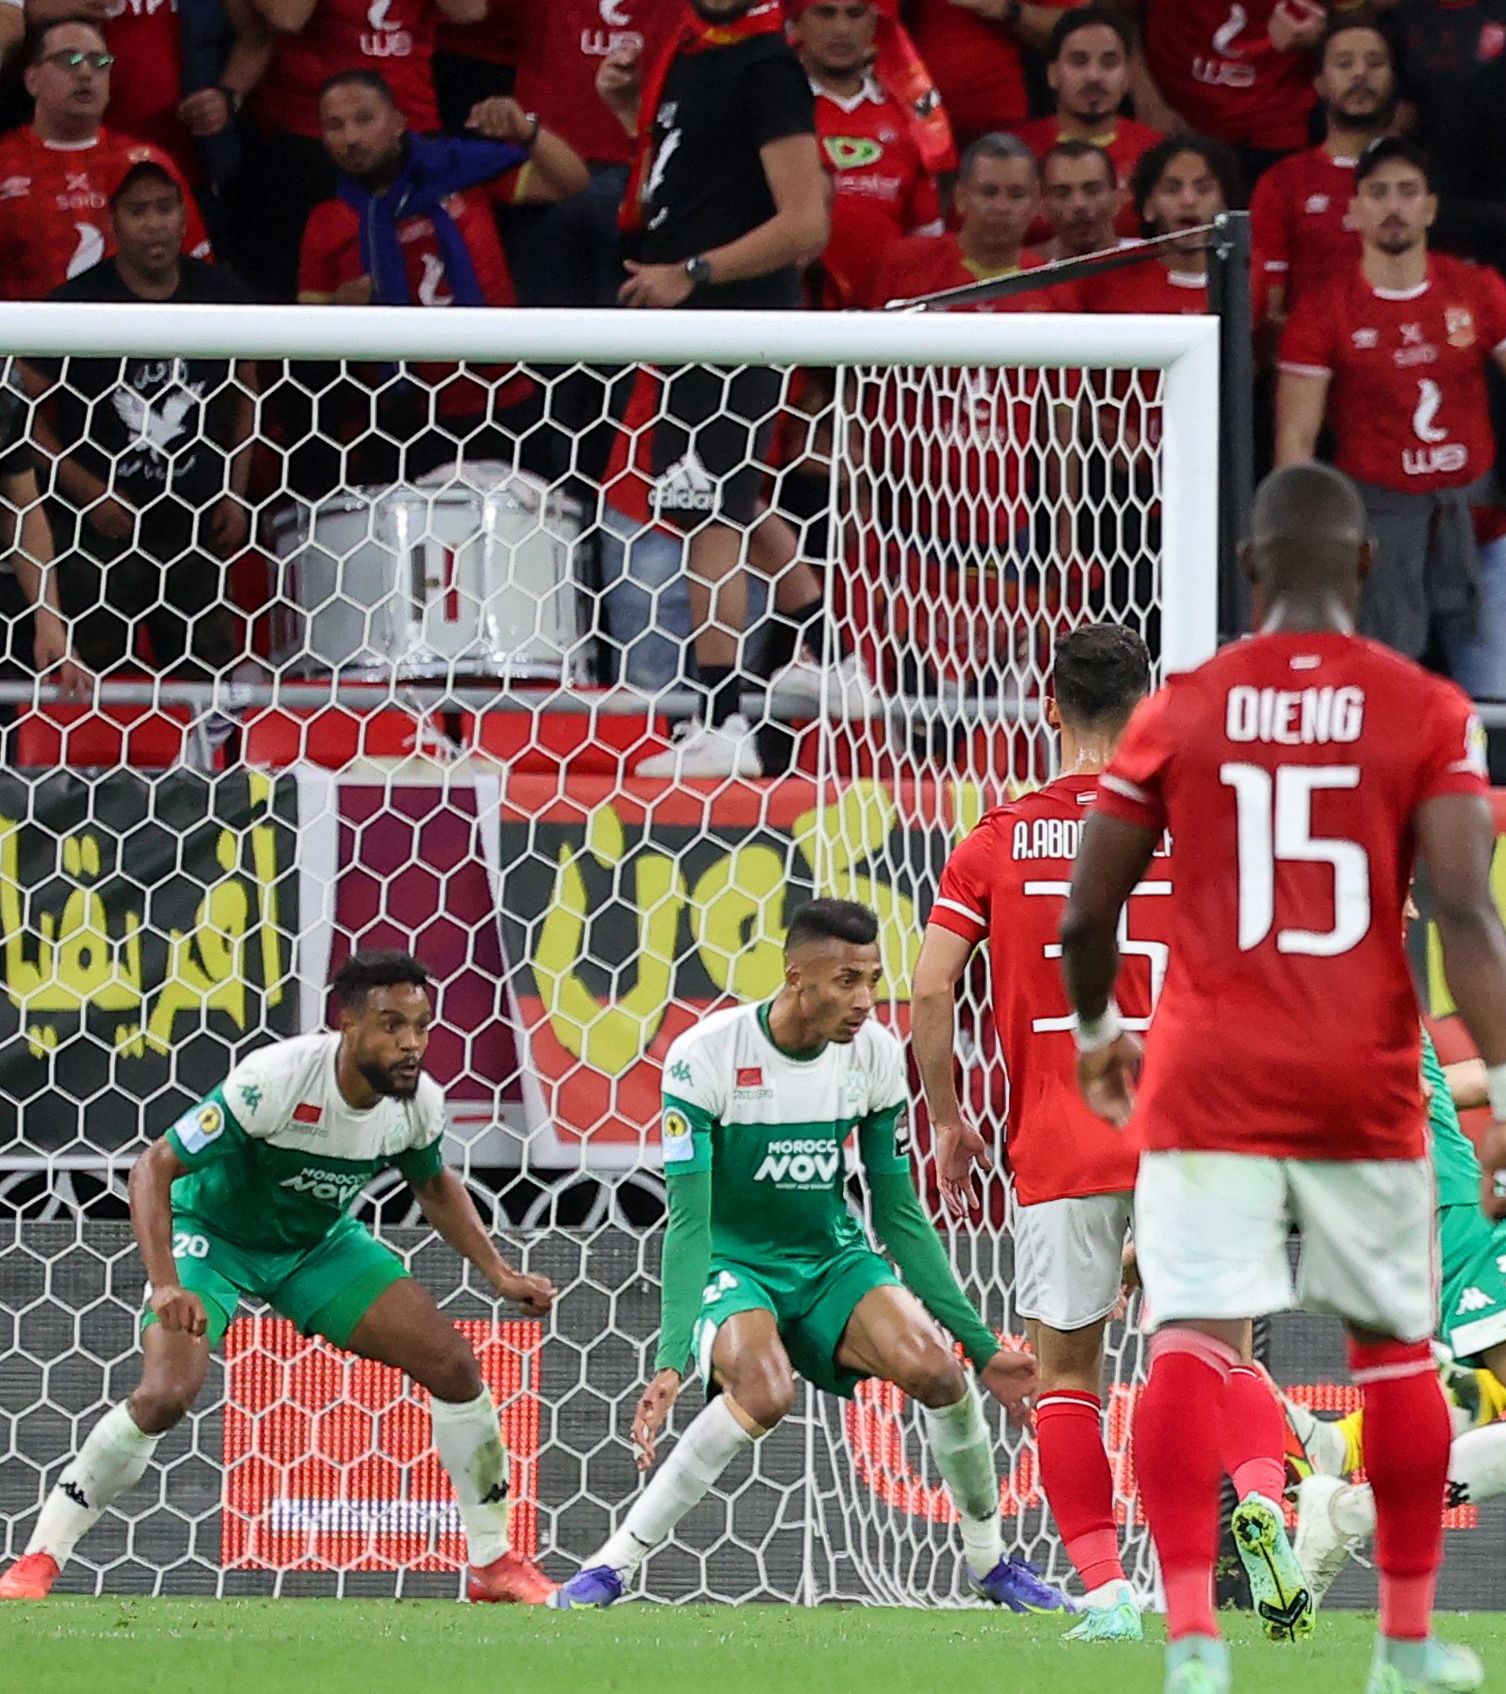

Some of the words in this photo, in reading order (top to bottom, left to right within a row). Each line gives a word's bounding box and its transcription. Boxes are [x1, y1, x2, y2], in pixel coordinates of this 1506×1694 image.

[1227, 685, 1364, 745] DIENG
[1220, 762, 1371, 957] 15
[768, 1139, 838, 1154] MOROCC
[172, 1232, 210, 1258] 20
